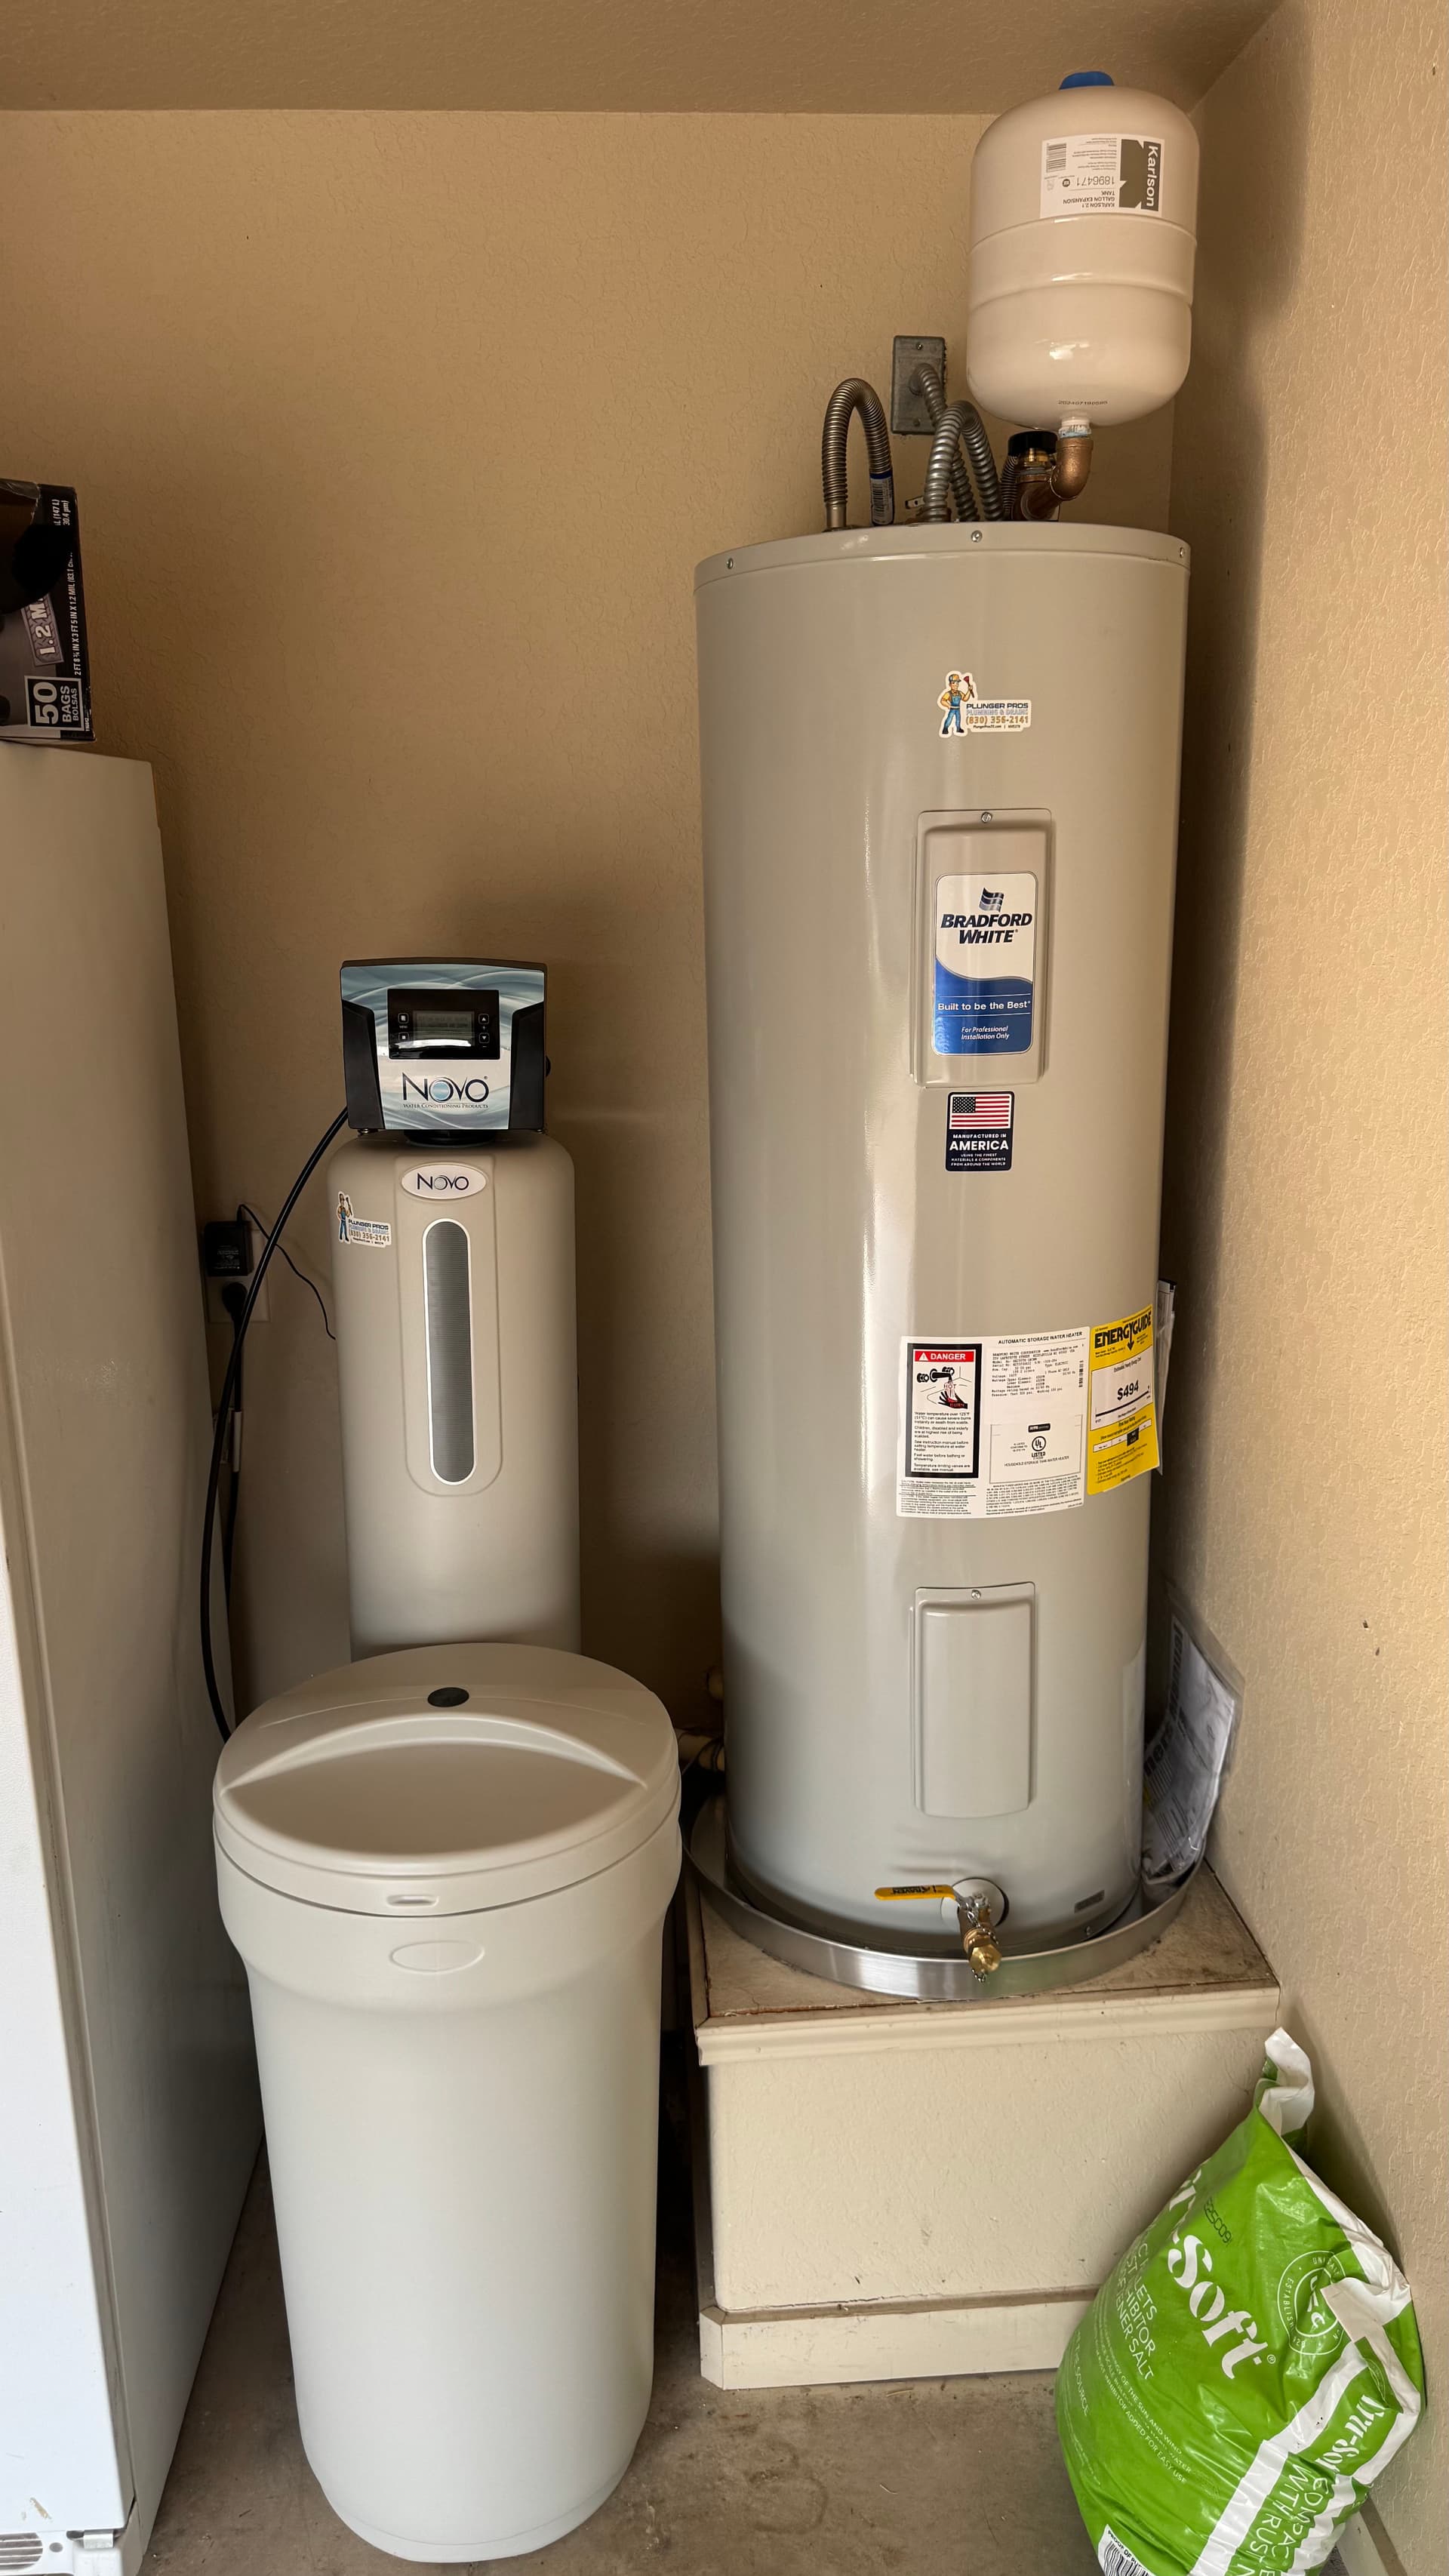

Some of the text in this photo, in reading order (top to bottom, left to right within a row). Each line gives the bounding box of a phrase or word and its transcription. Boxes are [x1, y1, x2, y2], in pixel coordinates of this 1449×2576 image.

[1077, 176, 1115, 186] 1896471
[1146, 145, 1158, 208] Karlson
[35, 625, 55, 656] 1.2
[74, 663, 81, 671] FT
[33, 682, 59, 725] 50
[60, 685, 72, 723] BAGS
[965, 716, 1029, 725] (830) 356-2141
[940, 913, 1033, 928] BRADFORD
[958, 929, 1015, 944] WHITE
[937, 1001, 1028, 1011] Built to be the Best
[949, 1140, 1009, 1151] AMERICA
[348, 1219, 372, 1228] PLUNGER
[1117, 1380, 1139, 1401] $494
[1129, 2337, 1154, 2380] SALT
[1121, 2375, 1182, 2454] OF THE SUN AND WIND
[1125, 2410, 1146, 2436] ADDED
[1145, 2436, 1158, 2452] FOR
[1157, 2451, 1173, 2470] EASY
[1246, 2464, 1312, 2563] WITH RUST
[1108, 2530, 1132, 2558] PROOF OF
